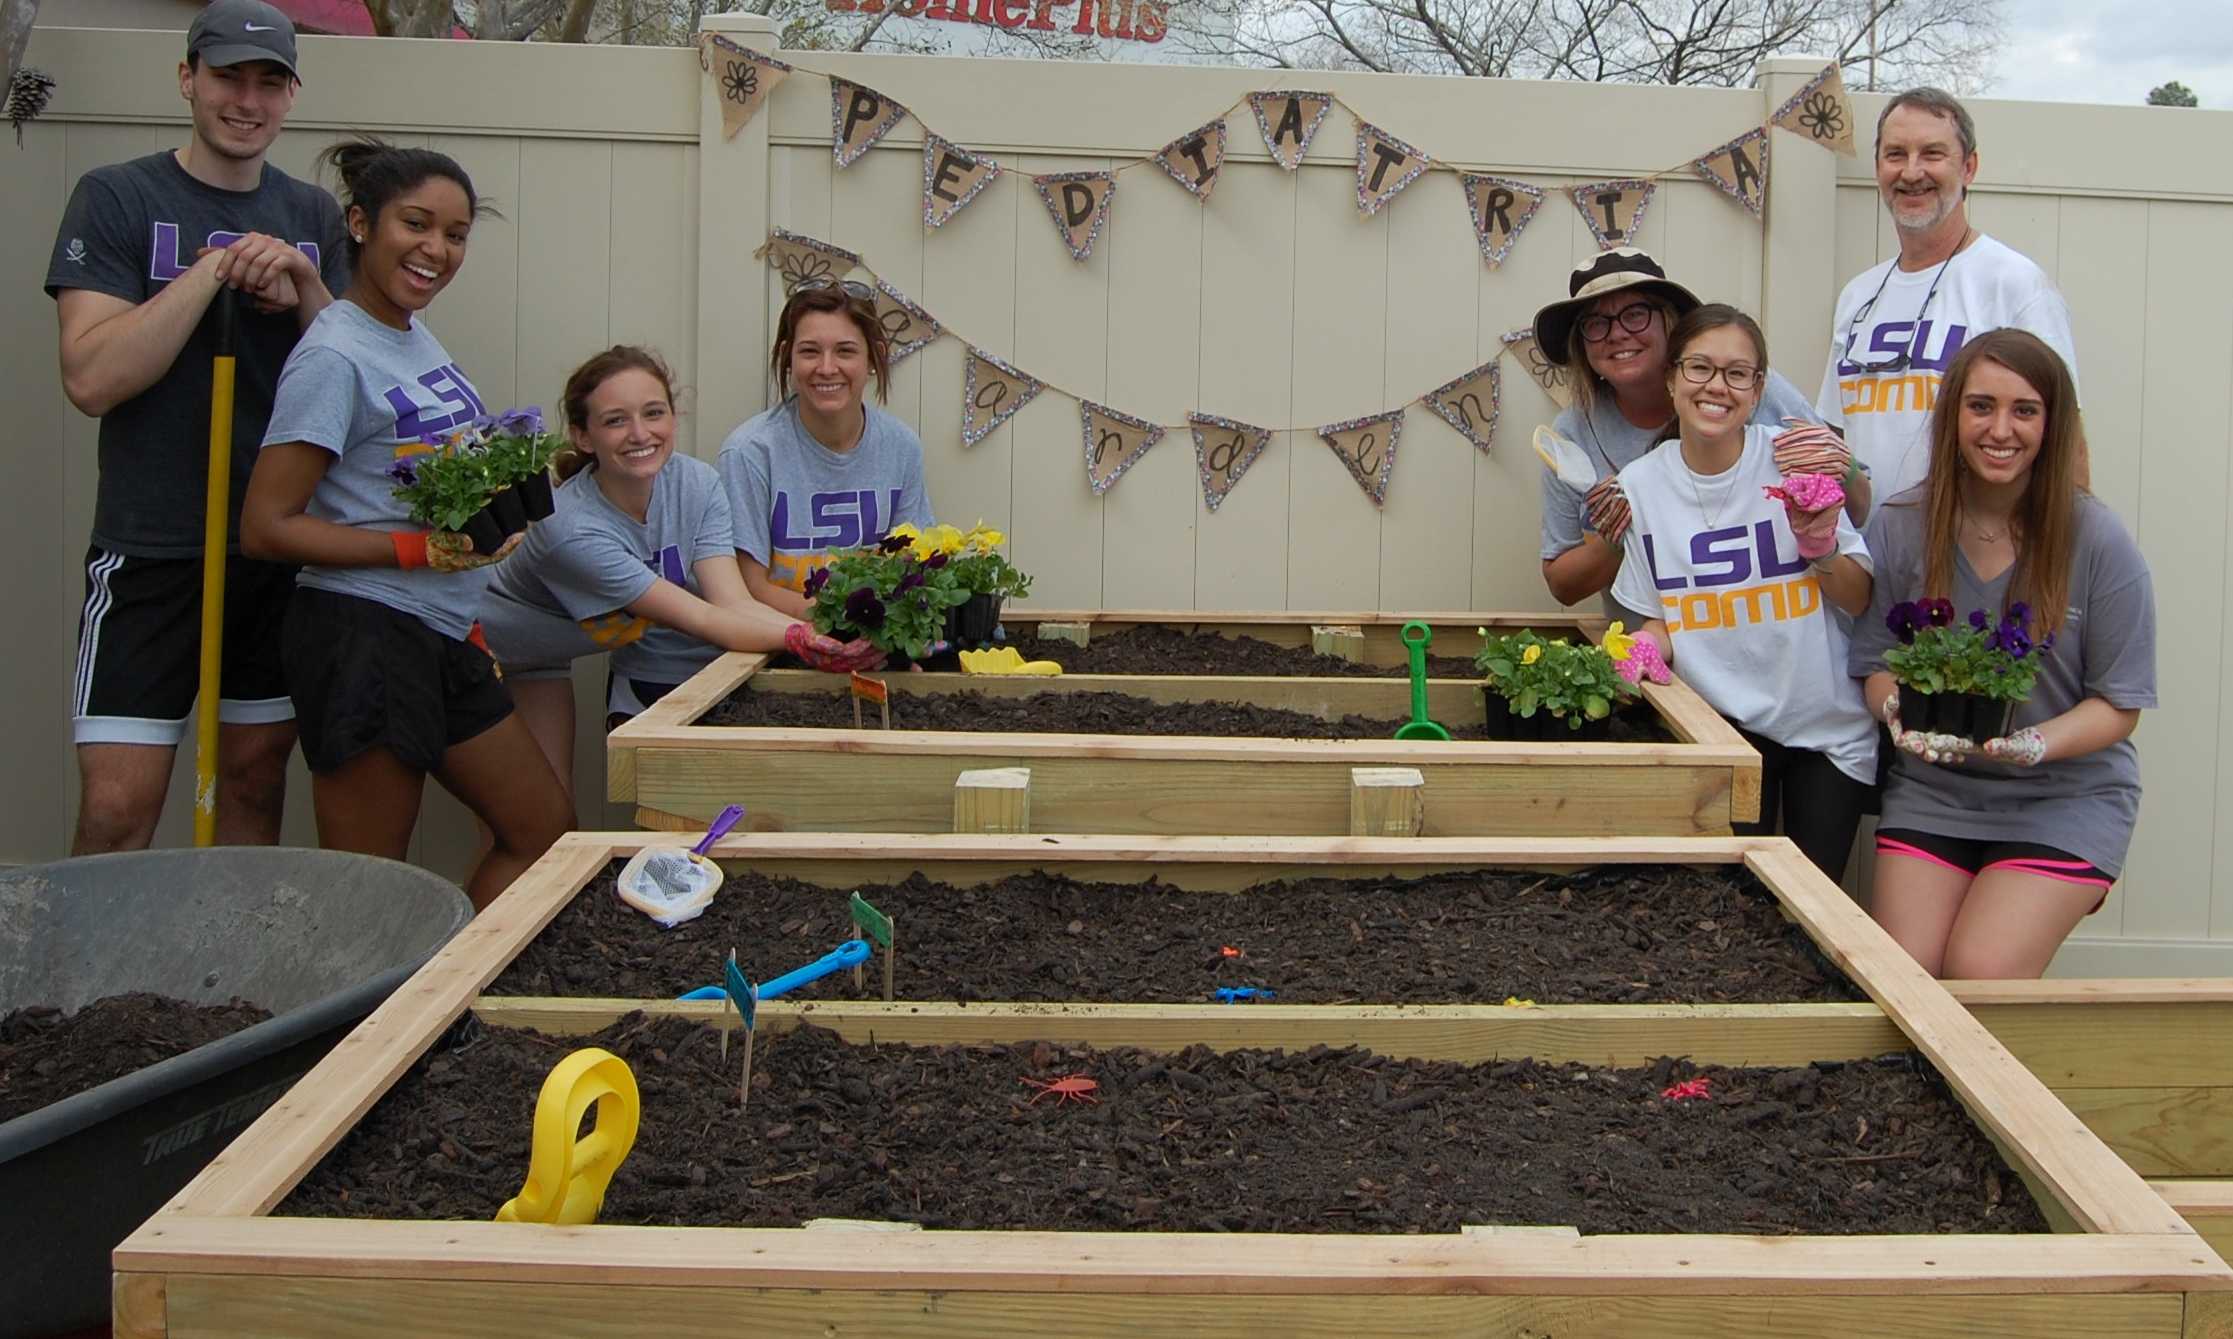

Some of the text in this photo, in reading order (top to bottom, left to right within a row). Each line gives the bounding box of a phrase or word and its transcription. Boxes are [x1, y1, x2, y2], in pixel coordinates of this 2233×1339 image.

[825, 0, 1168, 43] mePlus
[1837, 319, 1967, 377] LSU
[770, 487, 902, 551] LSU
[1642, 519, 1809, 590] LSU
